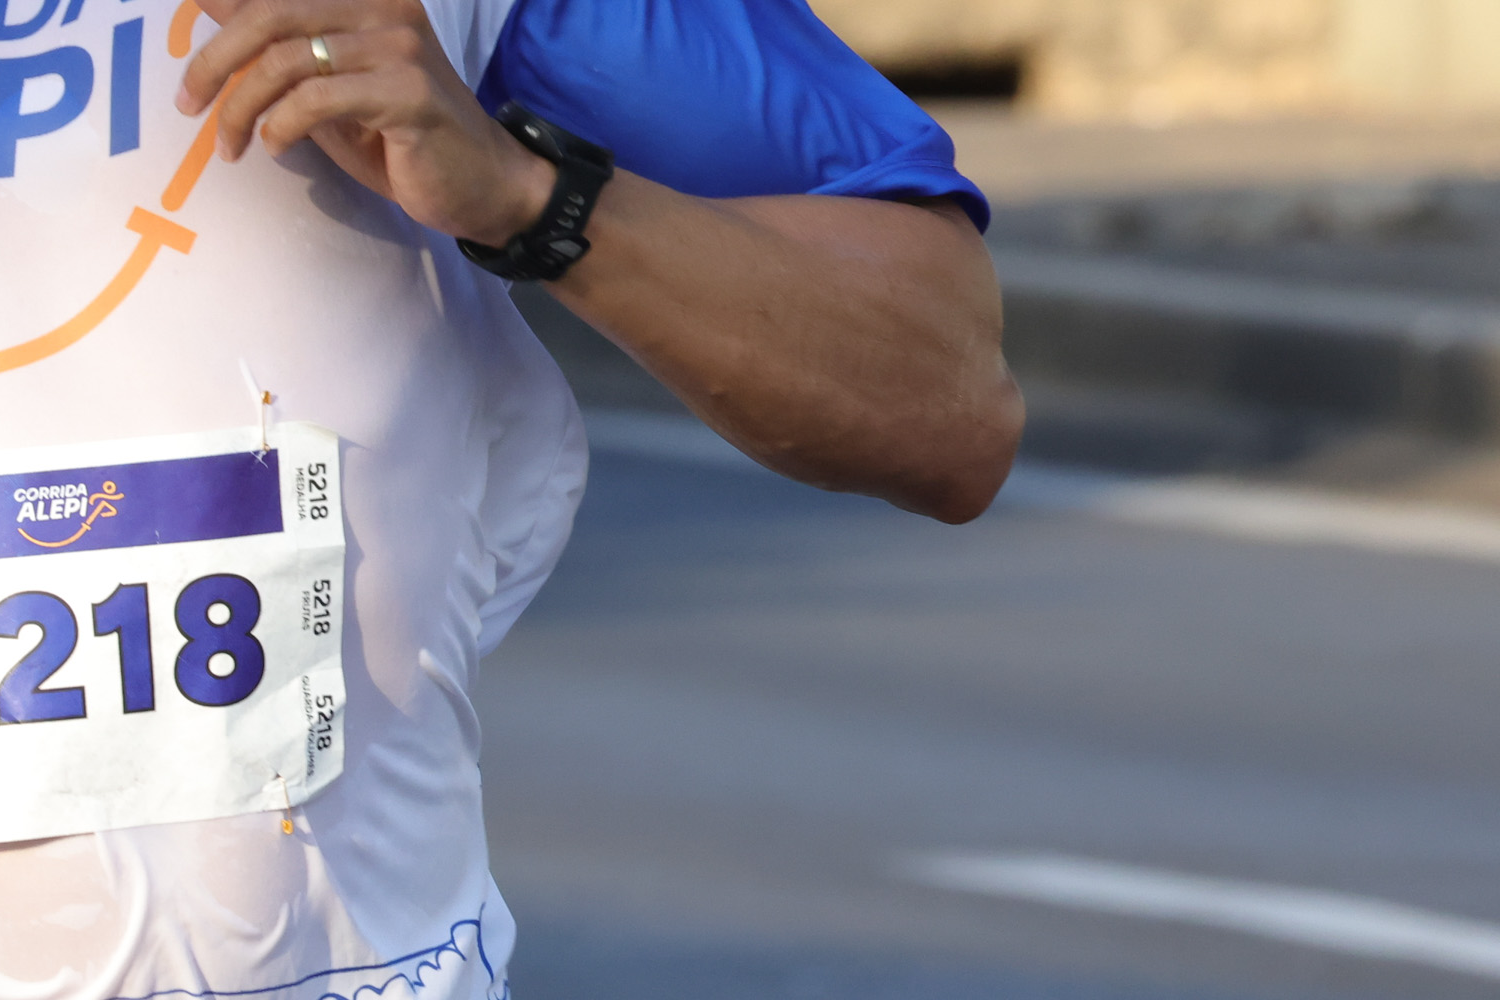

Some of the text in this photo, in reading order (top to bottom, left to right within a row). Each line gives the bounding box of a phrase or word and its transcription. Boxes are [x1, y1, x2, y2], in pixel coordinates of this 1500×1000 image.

[14, 483, 88, 502] CORRIDA
[16, 497, 88, 523] ALEPI
[295, 467, 307, 520] MEDALHA
[308, 462, 329, 520] 5218
[301, 590, 312, 632] FRUTAS
[313, 579, 332, 636] 5218
[316, 695, 334, 751] 5218
